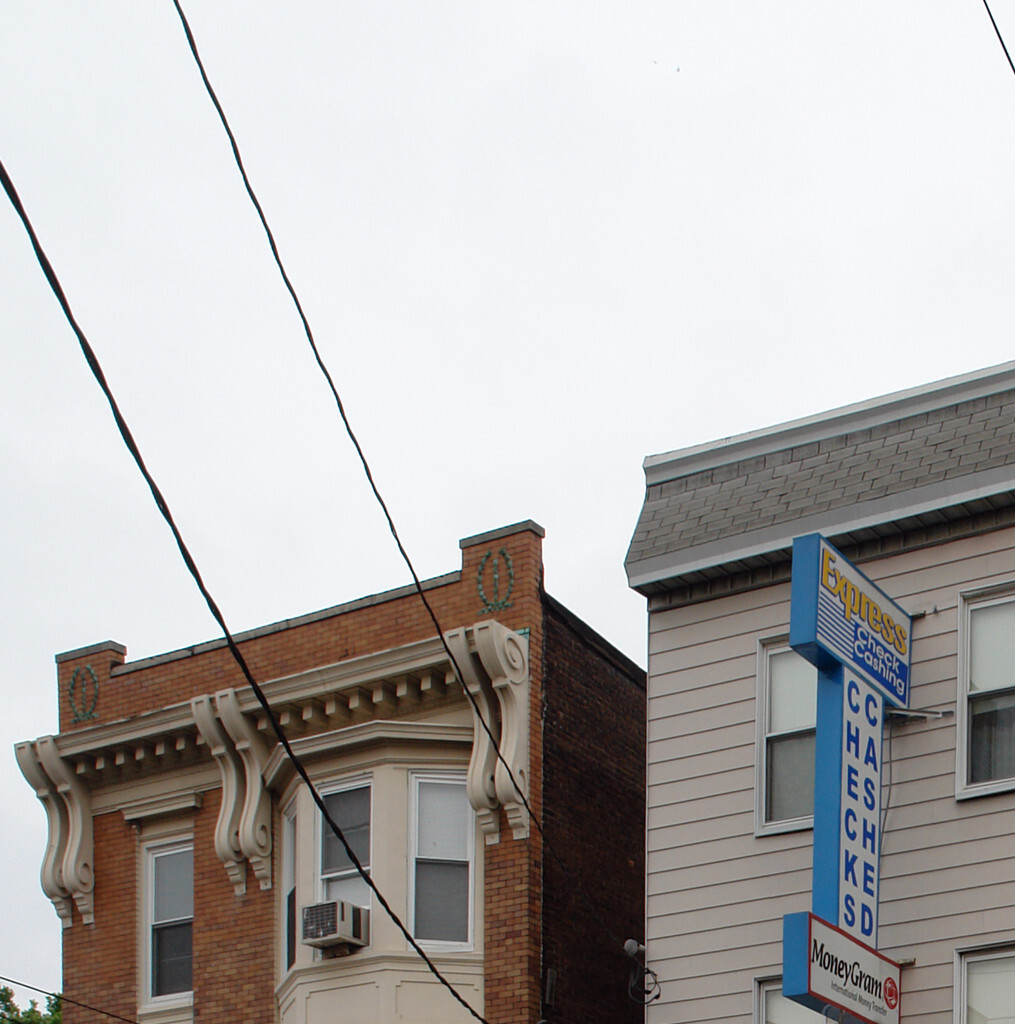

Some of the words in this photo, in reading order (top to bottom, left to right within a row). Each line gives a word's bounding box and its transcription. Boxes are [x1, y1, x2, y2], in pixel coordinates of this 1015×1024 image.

[821, 547, 907, 655] Express
[854, 639, 906, 697] Cashing
[855, 626, 900, 674] Check
[844, 680, 860, 927] CHECKS
[861, 693, 880, 937] CASHED
[811, 938, 882, 999] MoneyGram
